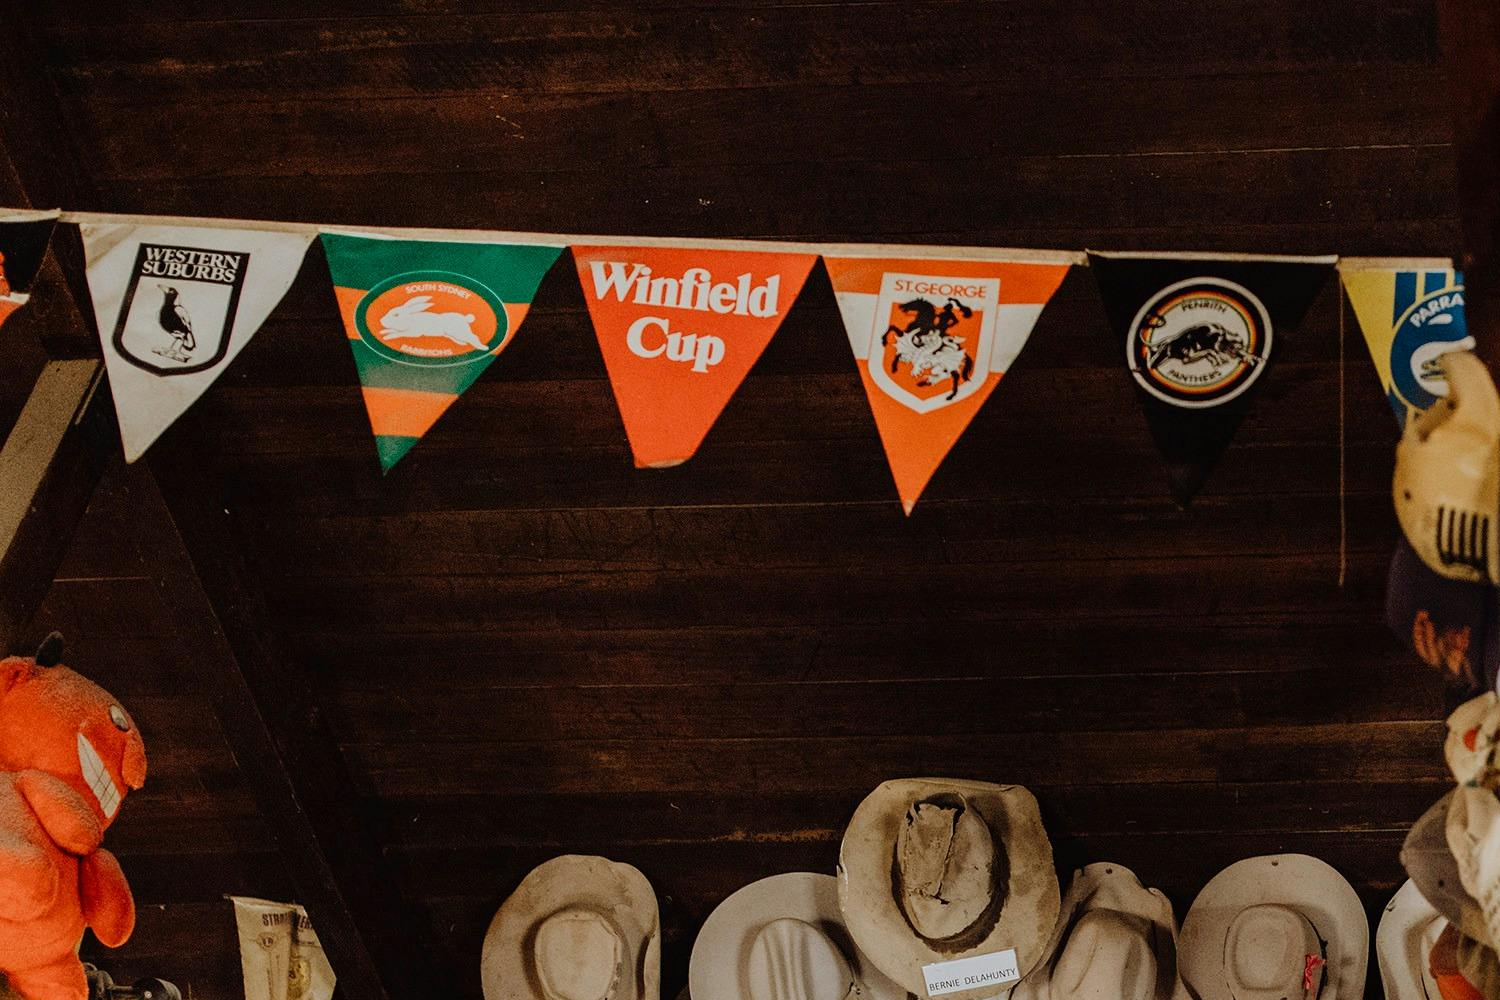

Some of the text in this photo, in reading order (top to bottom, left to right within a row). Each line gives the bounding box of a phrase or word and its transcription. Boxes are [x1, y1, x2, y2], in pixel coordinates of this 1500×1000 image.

[145, 246, 241, 270] WESTERN
[141, 260, 236, 283] SUBURBS
[589, 261, 781, 318] Winfield
[895, 278, 987, 299] ST.GEORGE
[626, 316, 726, 373] Cup
[928, 968, 1018, 993] BERNIE DELAHUNTY
